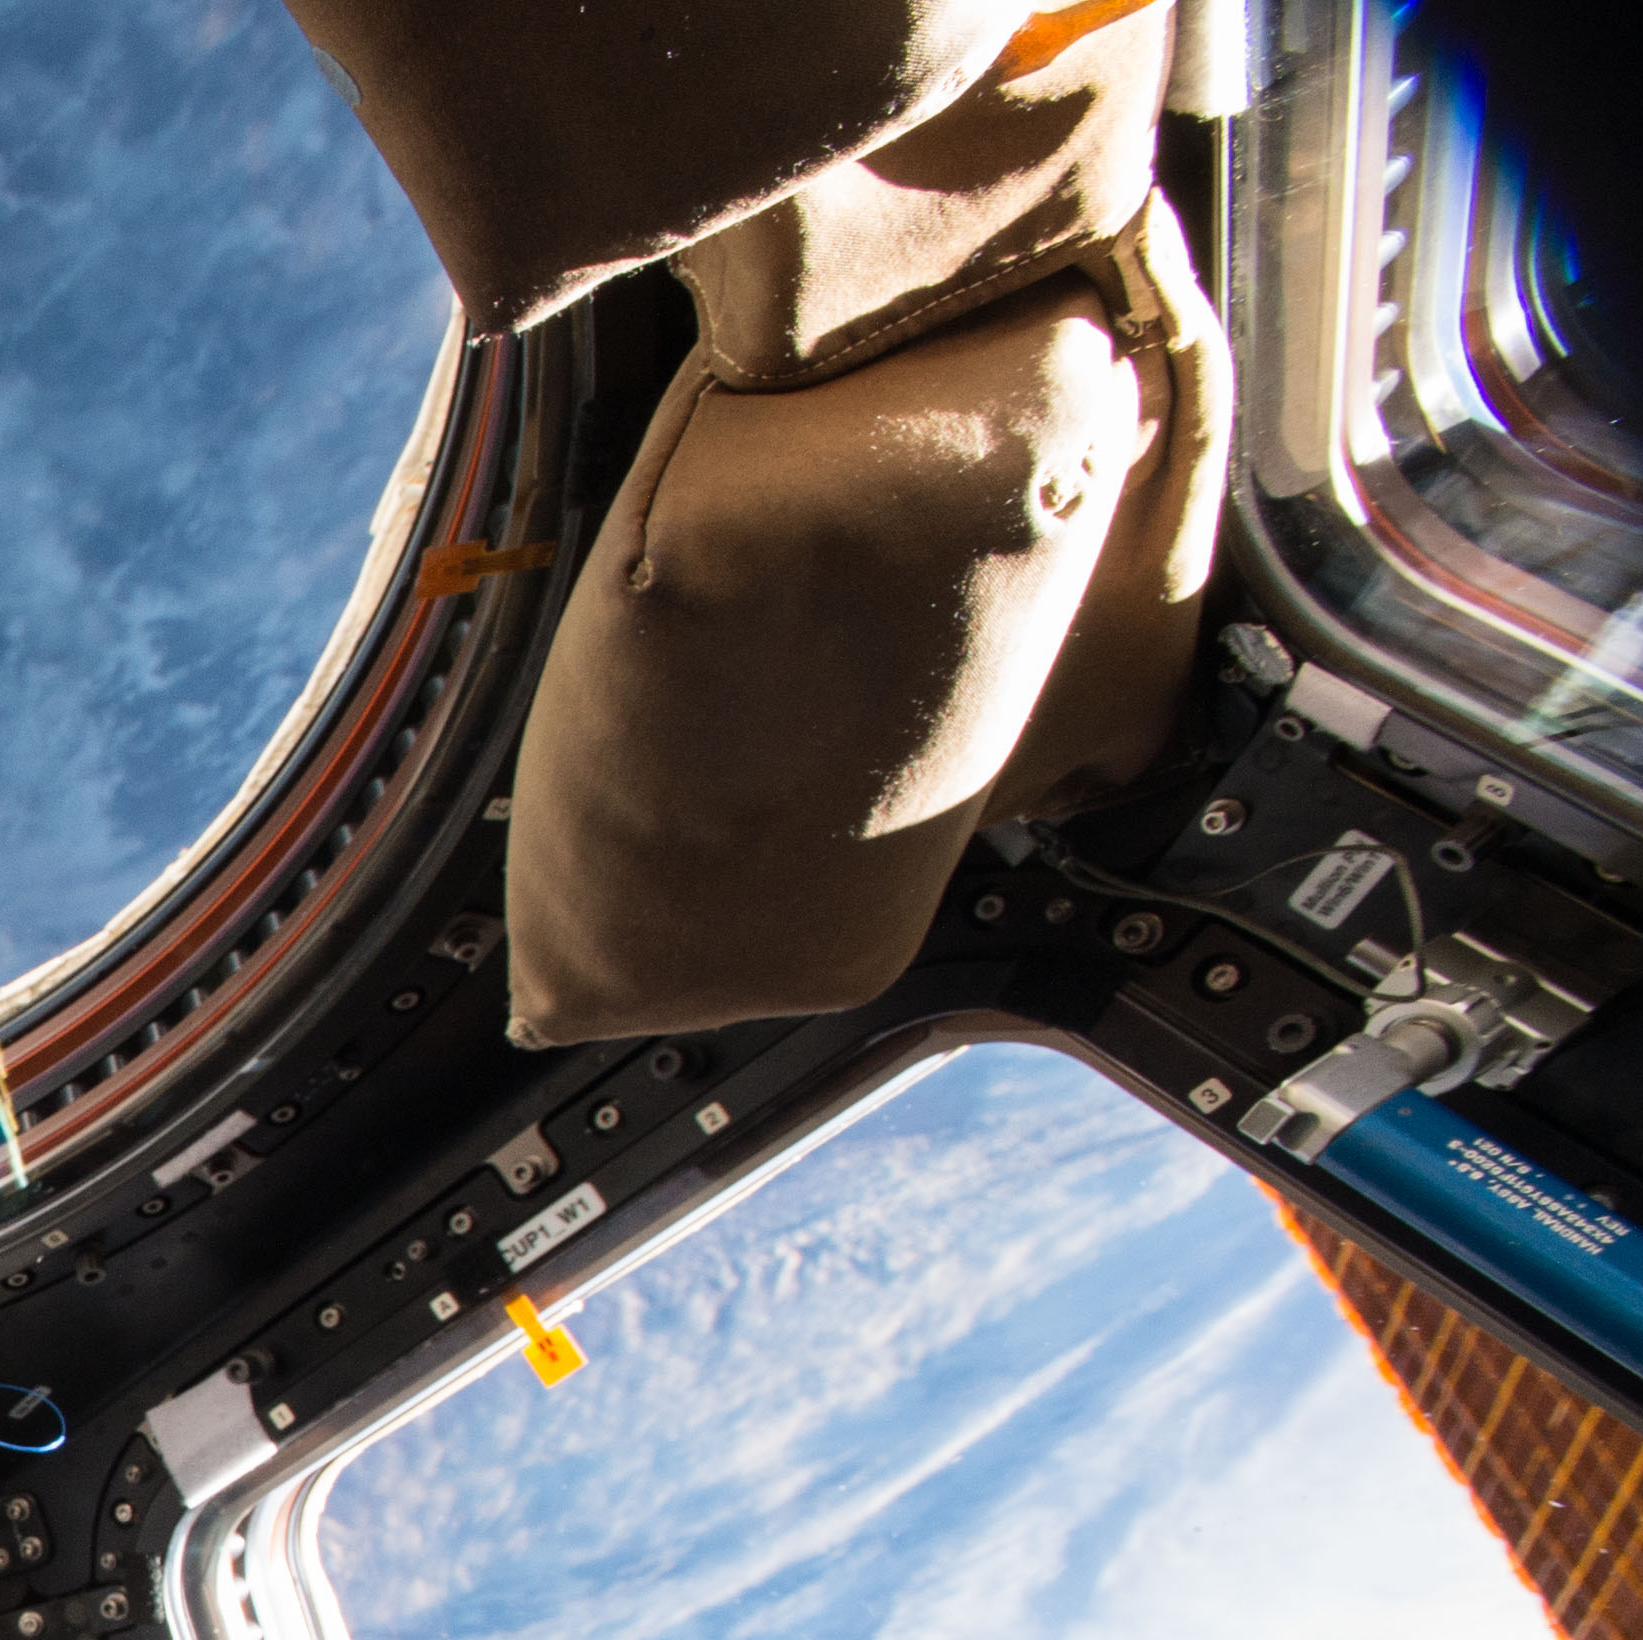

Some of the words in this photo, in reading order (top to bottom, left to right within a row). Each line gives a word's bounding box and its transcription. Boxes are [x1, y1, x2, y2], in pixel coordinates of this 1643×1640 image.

[1202, 1088, 1219, 1104] 3
[1531, 1206, 1605, 1256] HANDRAIL
[438, 1298, 452, 1313] A
